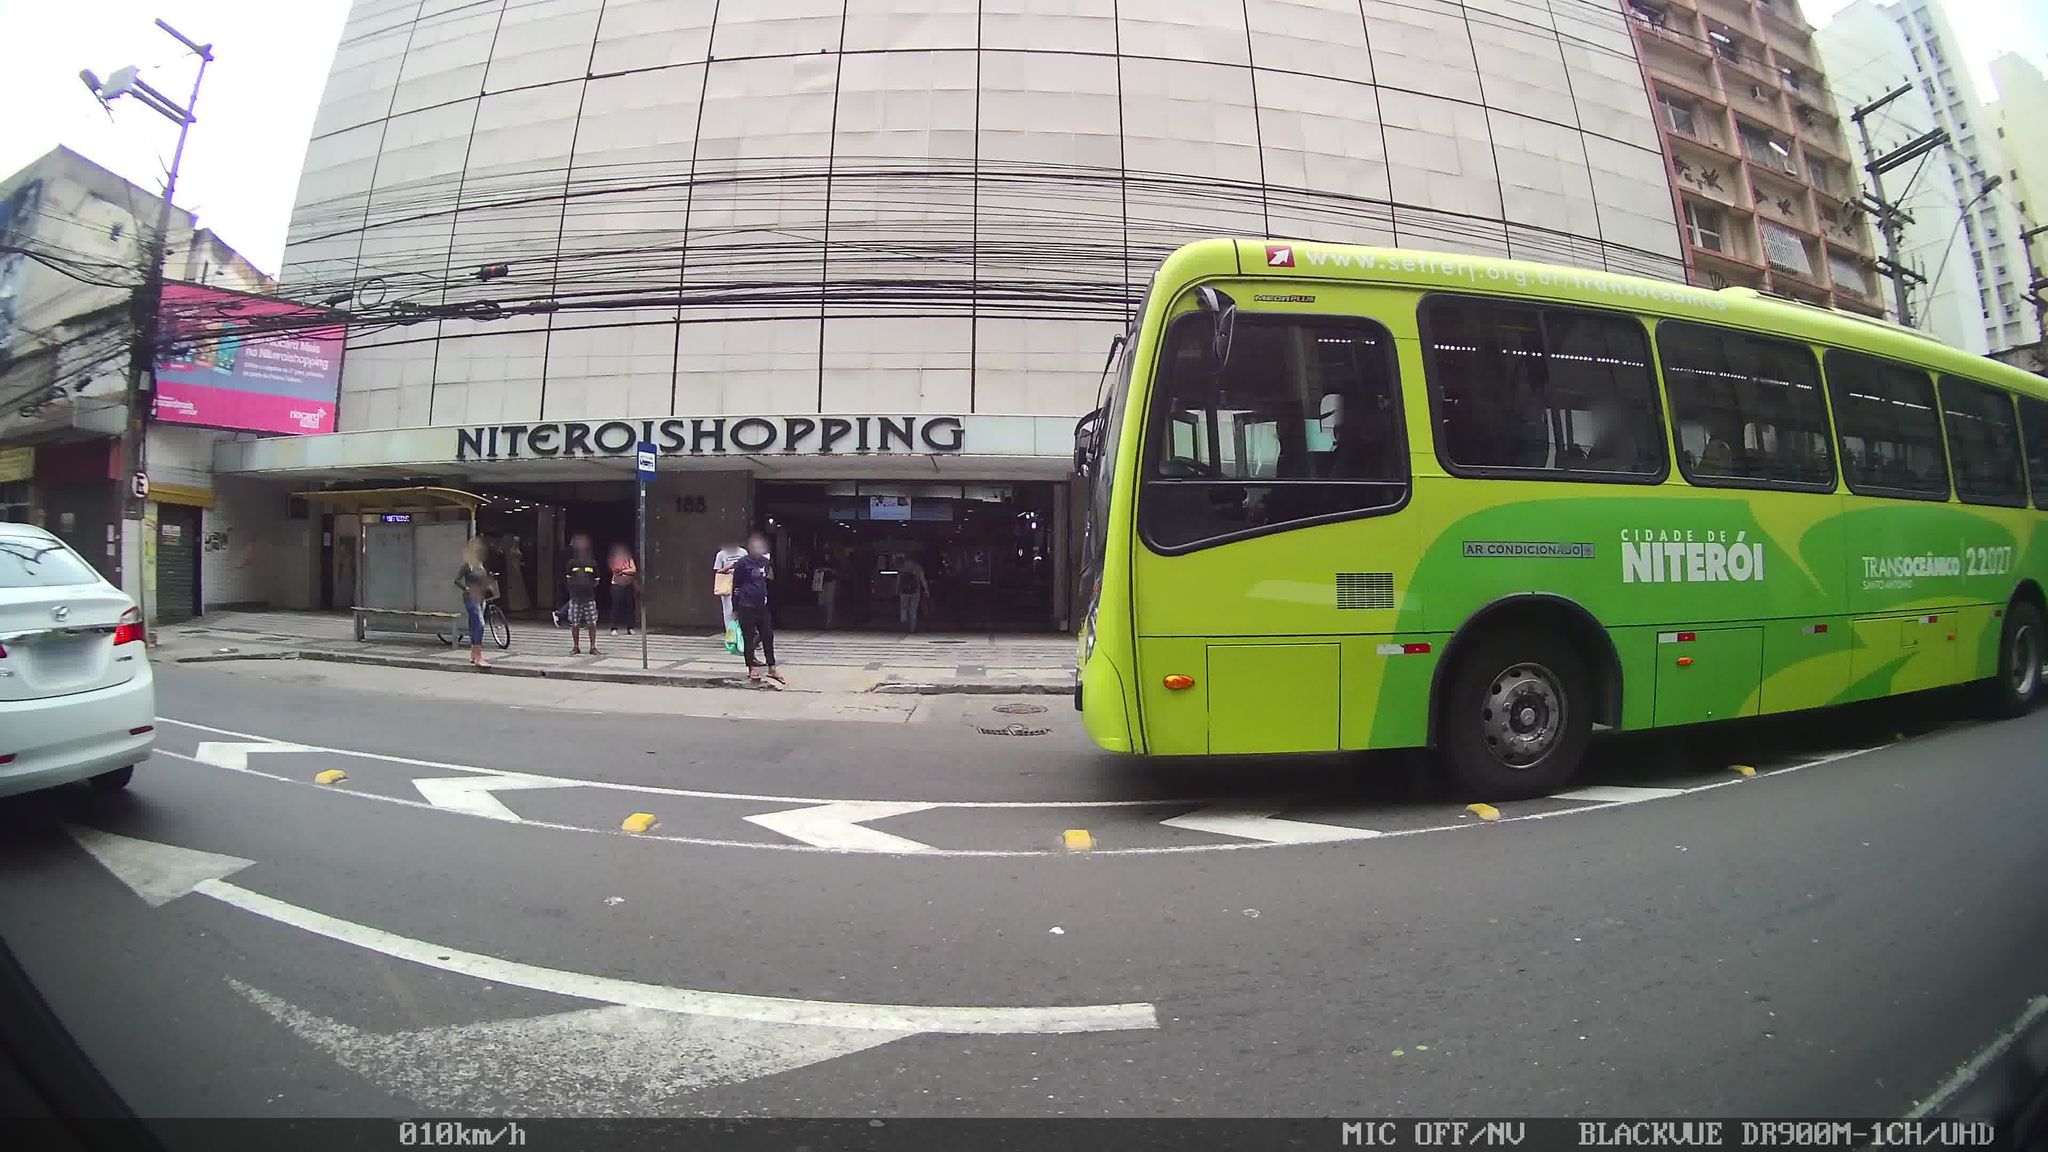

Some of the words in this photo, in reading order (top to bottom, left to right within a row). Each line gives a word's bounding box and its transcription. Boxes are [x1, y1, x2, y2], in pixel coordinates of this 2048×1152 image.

[1620, 529, 1694, 542] CIDADE
[1707, 529, 1727, 542] DE
[1465, 544, 1484, 555] AR
[1487, 543, 1581, 556] CONDICIONADO
[1621, 530, 1764, 583] NITERÓI
[1861, 551, 1962, 578] TRANSOCEÂNICO
